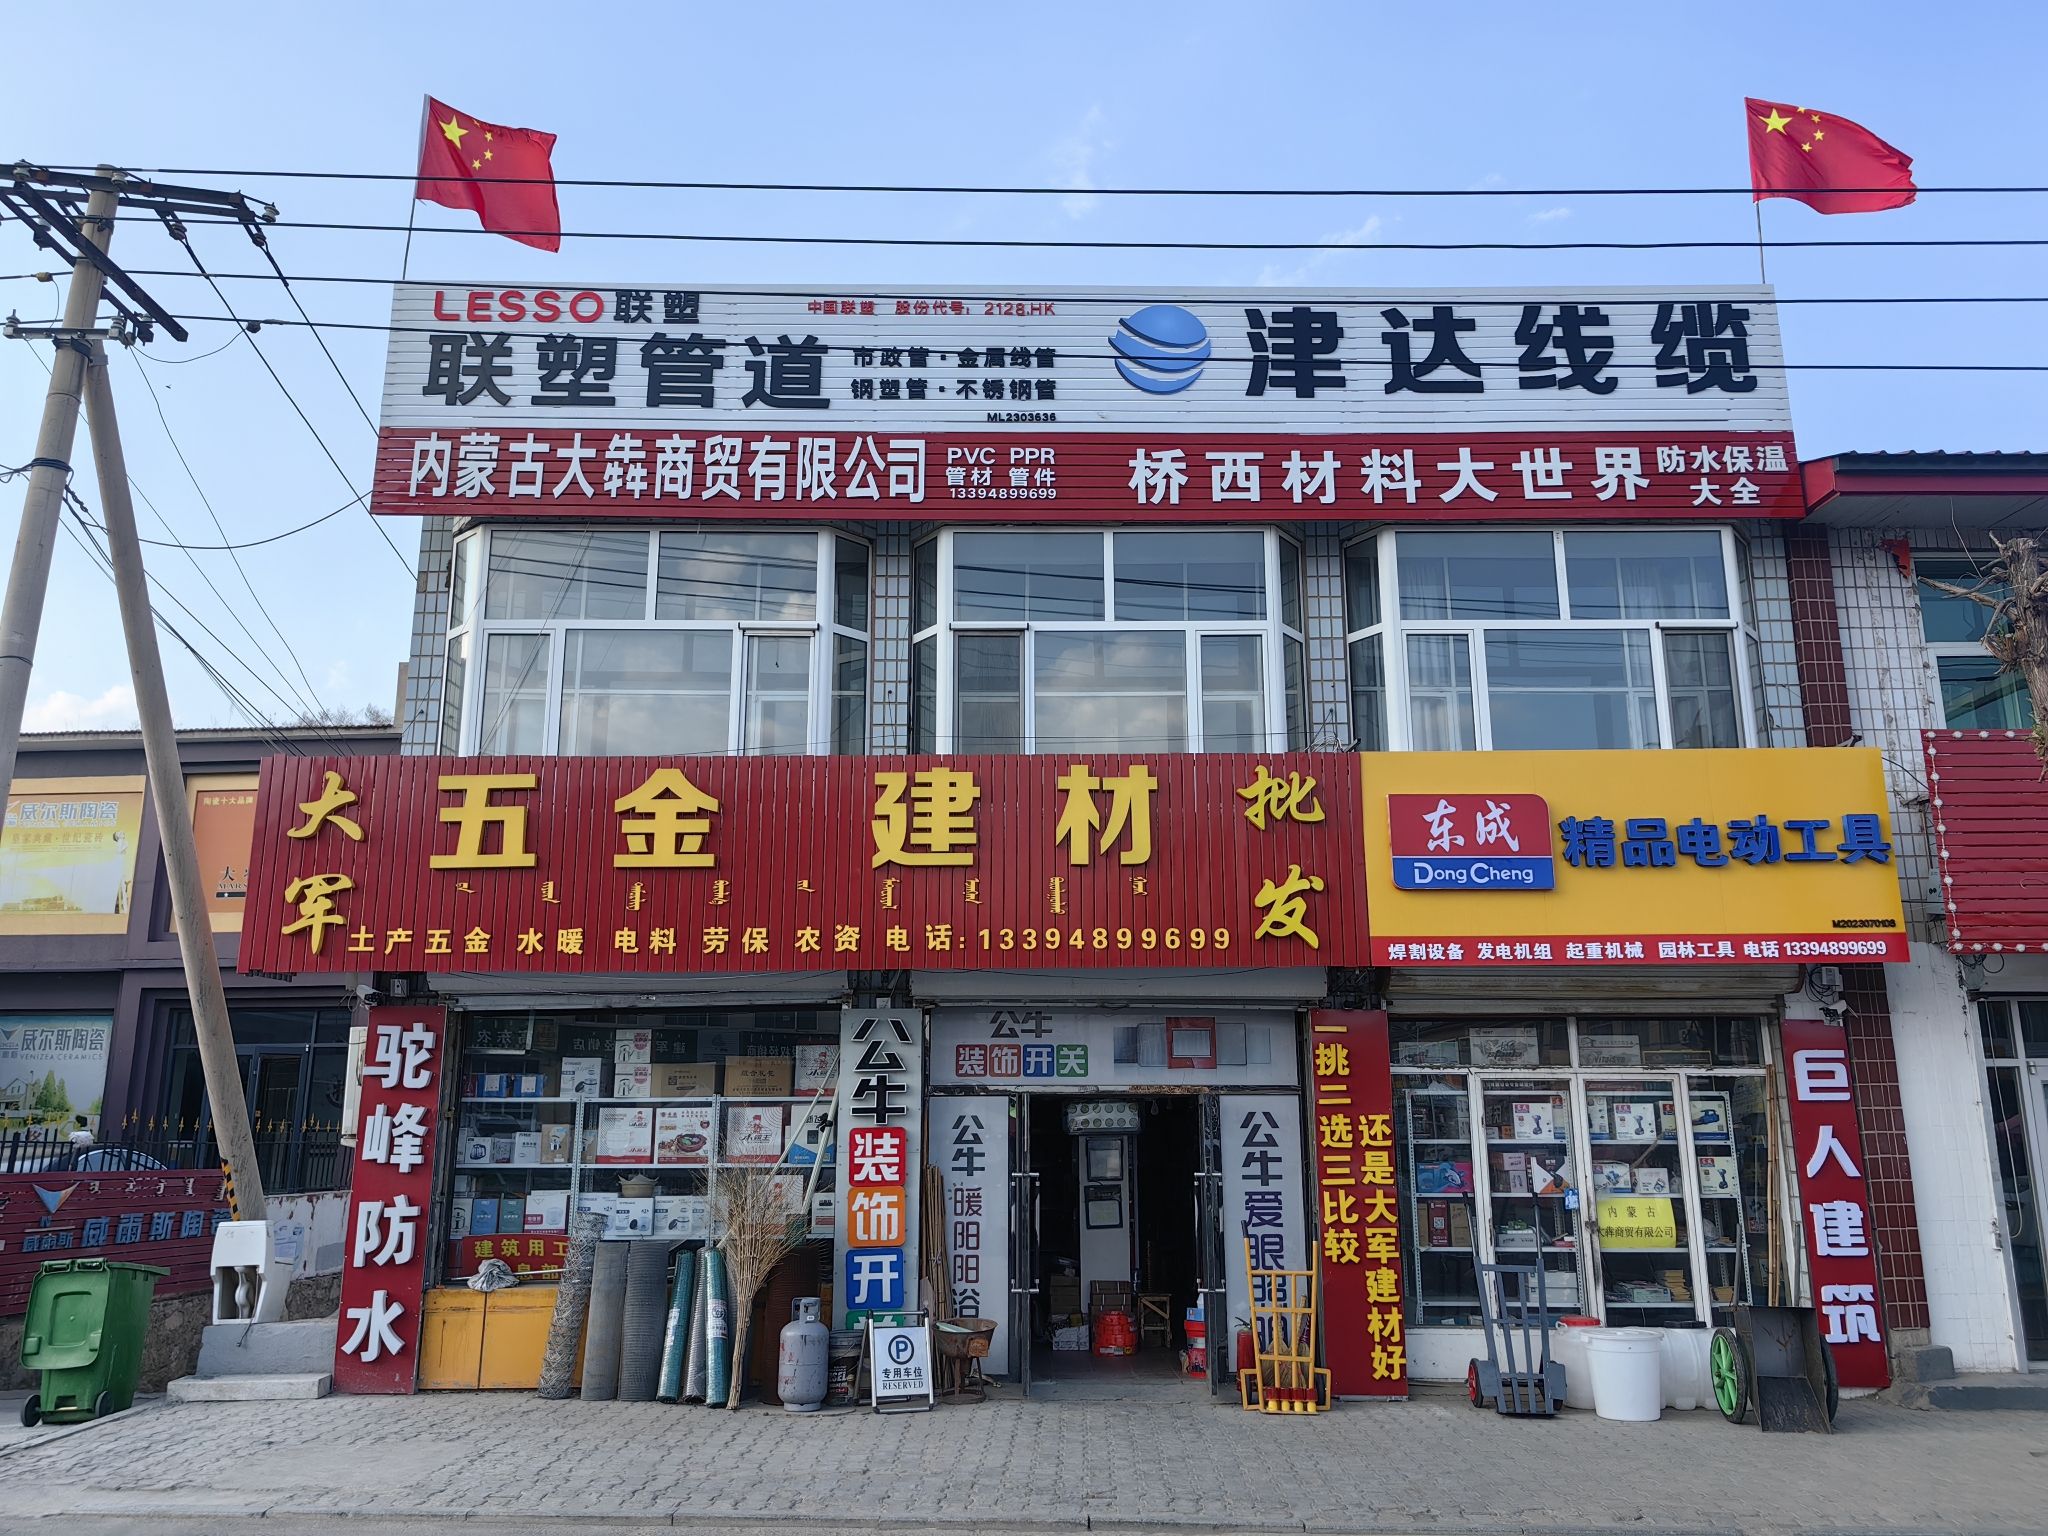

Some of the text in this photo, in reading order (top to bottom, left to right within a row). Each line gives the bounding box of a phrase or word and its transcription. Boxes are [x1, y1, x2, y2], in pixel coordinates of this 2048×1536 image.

[434, 290, 700, 324] LESSO 联塑
[984, 302, 1056, 316] 2128.HK
[1245, 303, 1757, 398] 津达线缆
[421, 331, 831, 409] 联塑管道
[987, 412, 1057, 422] ML2303636
[409, 432, 926, 503] 内蒙古大犇商贸有限公司
[947, 447, 1056, 465] PVC PPR
[1657, 443, 1789, 473] 防水保温
[945, 467, 1056, 487] 管材 管件
[1128, 447, 1650, 504] 桥西材料大世界
[1690, 476, 1761, 506] 大全
[950, 488, 1057, 499] 13394899699
[430, 765, 1158, 868] 五金建材
[1422, 799, 1519, 852] 东成
[1558, 813, 1891, 868] 精品电动工具
[281, 771, 364, 955] 大军
[1236, 765, 1325, 949] 批发
[348, 926, 491, 954] 土产五金
[516, 927, 584, 955] 水暖
[614, 926, 677, 954] 电料
[702, 926, 769, 954] 劳保
[795, 924, 861, 952] 农资
[1388, 940, 1887, 961] 焊割设备 发电机组 起重机械 园林工具 电话 13394899699
[21, 1028, 105, 1052] 威尔斯陶瓷
[990, 1011, 1053, 1039] 公牛
[958, 1047, 1084, 1075] 装饰开关
[1314, 1025, 1359, 1265] 一挑二选三比较
[341, 1022, 435, 1362] 驼峰防水
[1793, 1050, 1881, 1344] 巨人建筑
[474, 1239, 568, 1258] 建筑用工
[1358, 1113, 1407, 1381] 还是大军建材好
[881, 1366, 923, 1379] 专用车位
[882, 1381, 924, 1390] RESERVED
